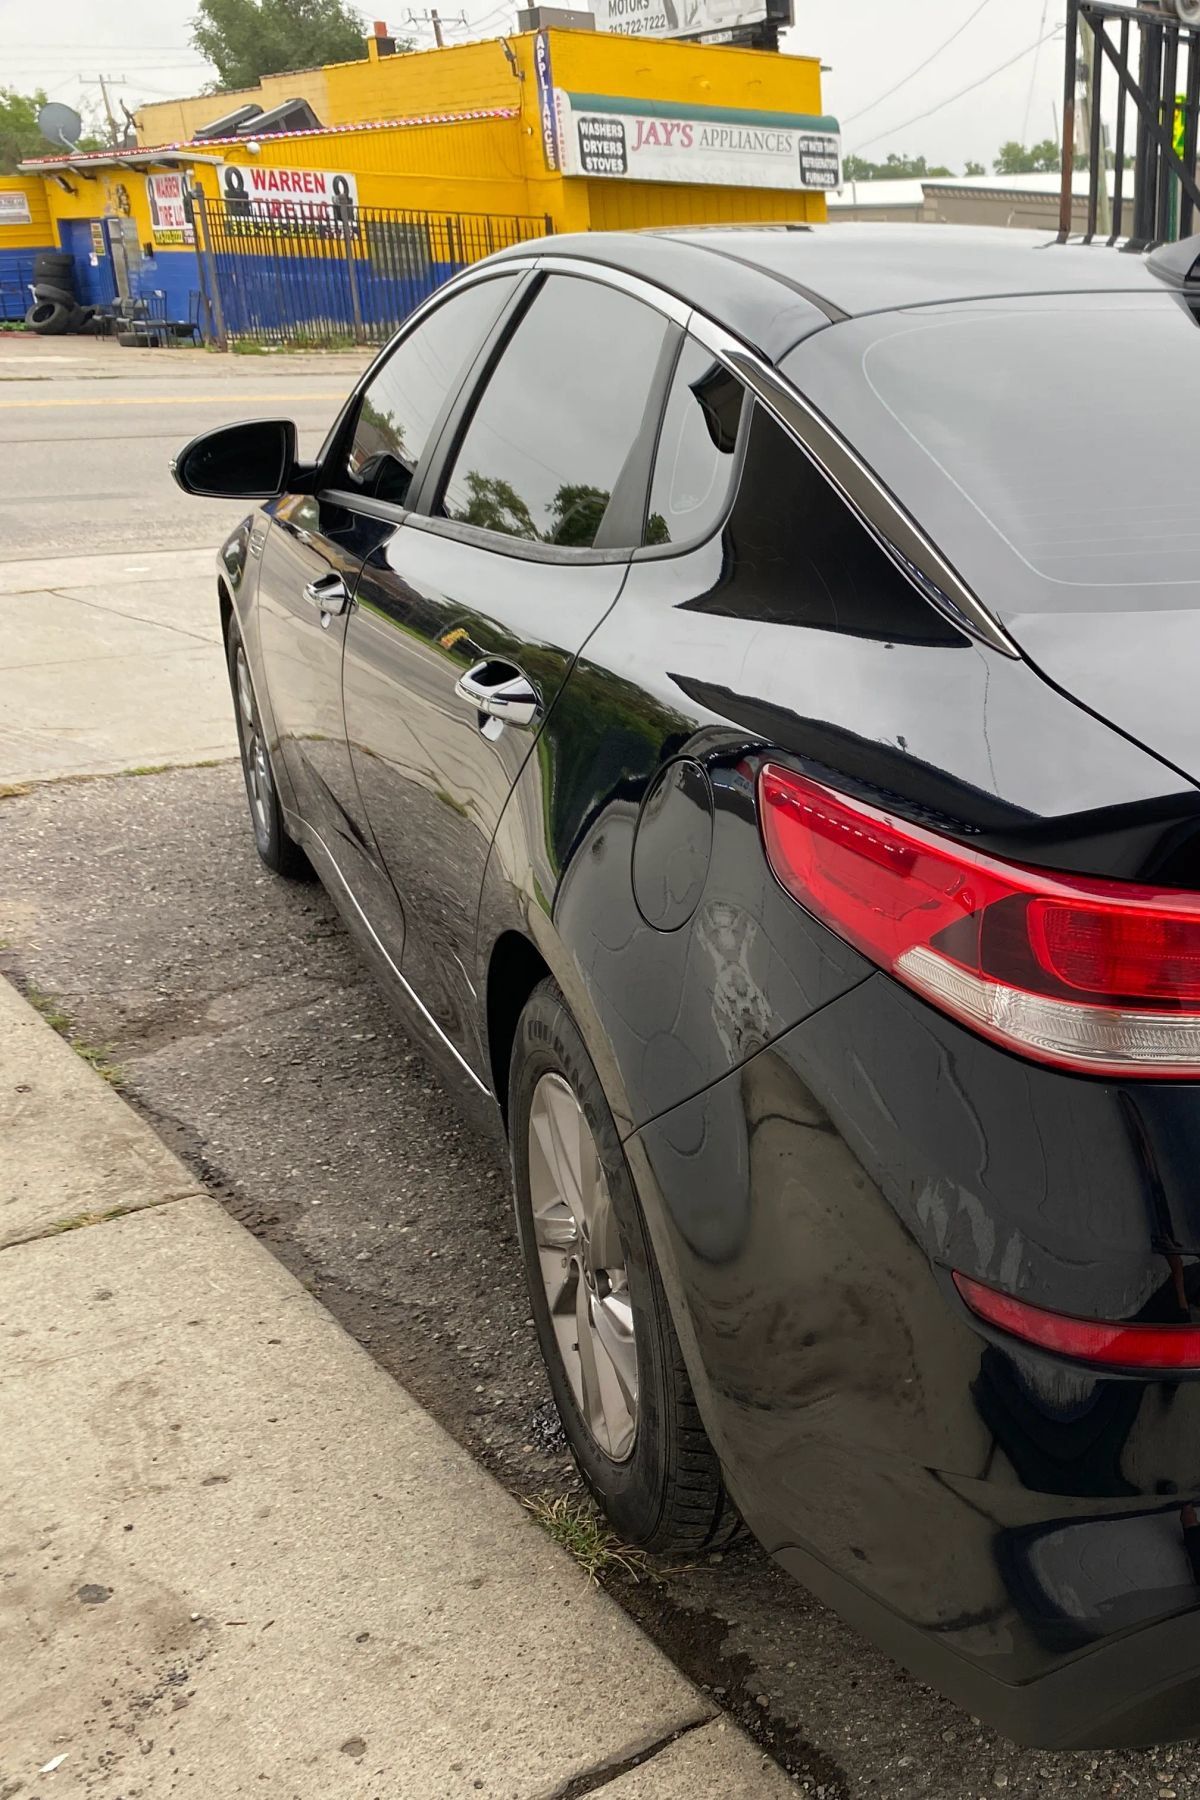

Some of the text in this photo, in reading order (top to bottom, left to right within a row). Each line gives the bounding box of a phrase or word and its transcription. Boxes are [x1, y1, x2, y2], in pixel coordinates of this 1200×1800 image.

[608, 0, 650, 18] MOTORS
[536, 34, 557, 170] APPLIANCES
[579, 122, 624, 138] WASHERS
[631, 119, 793, 153] JAY'S APPLIANCES
[582, 140, 624, 156] DRYERS
[585, 157, 625, 172] STOVES
[155, 175, 180, 198] WARREN
[250, 168, 326, 194] WARREN
